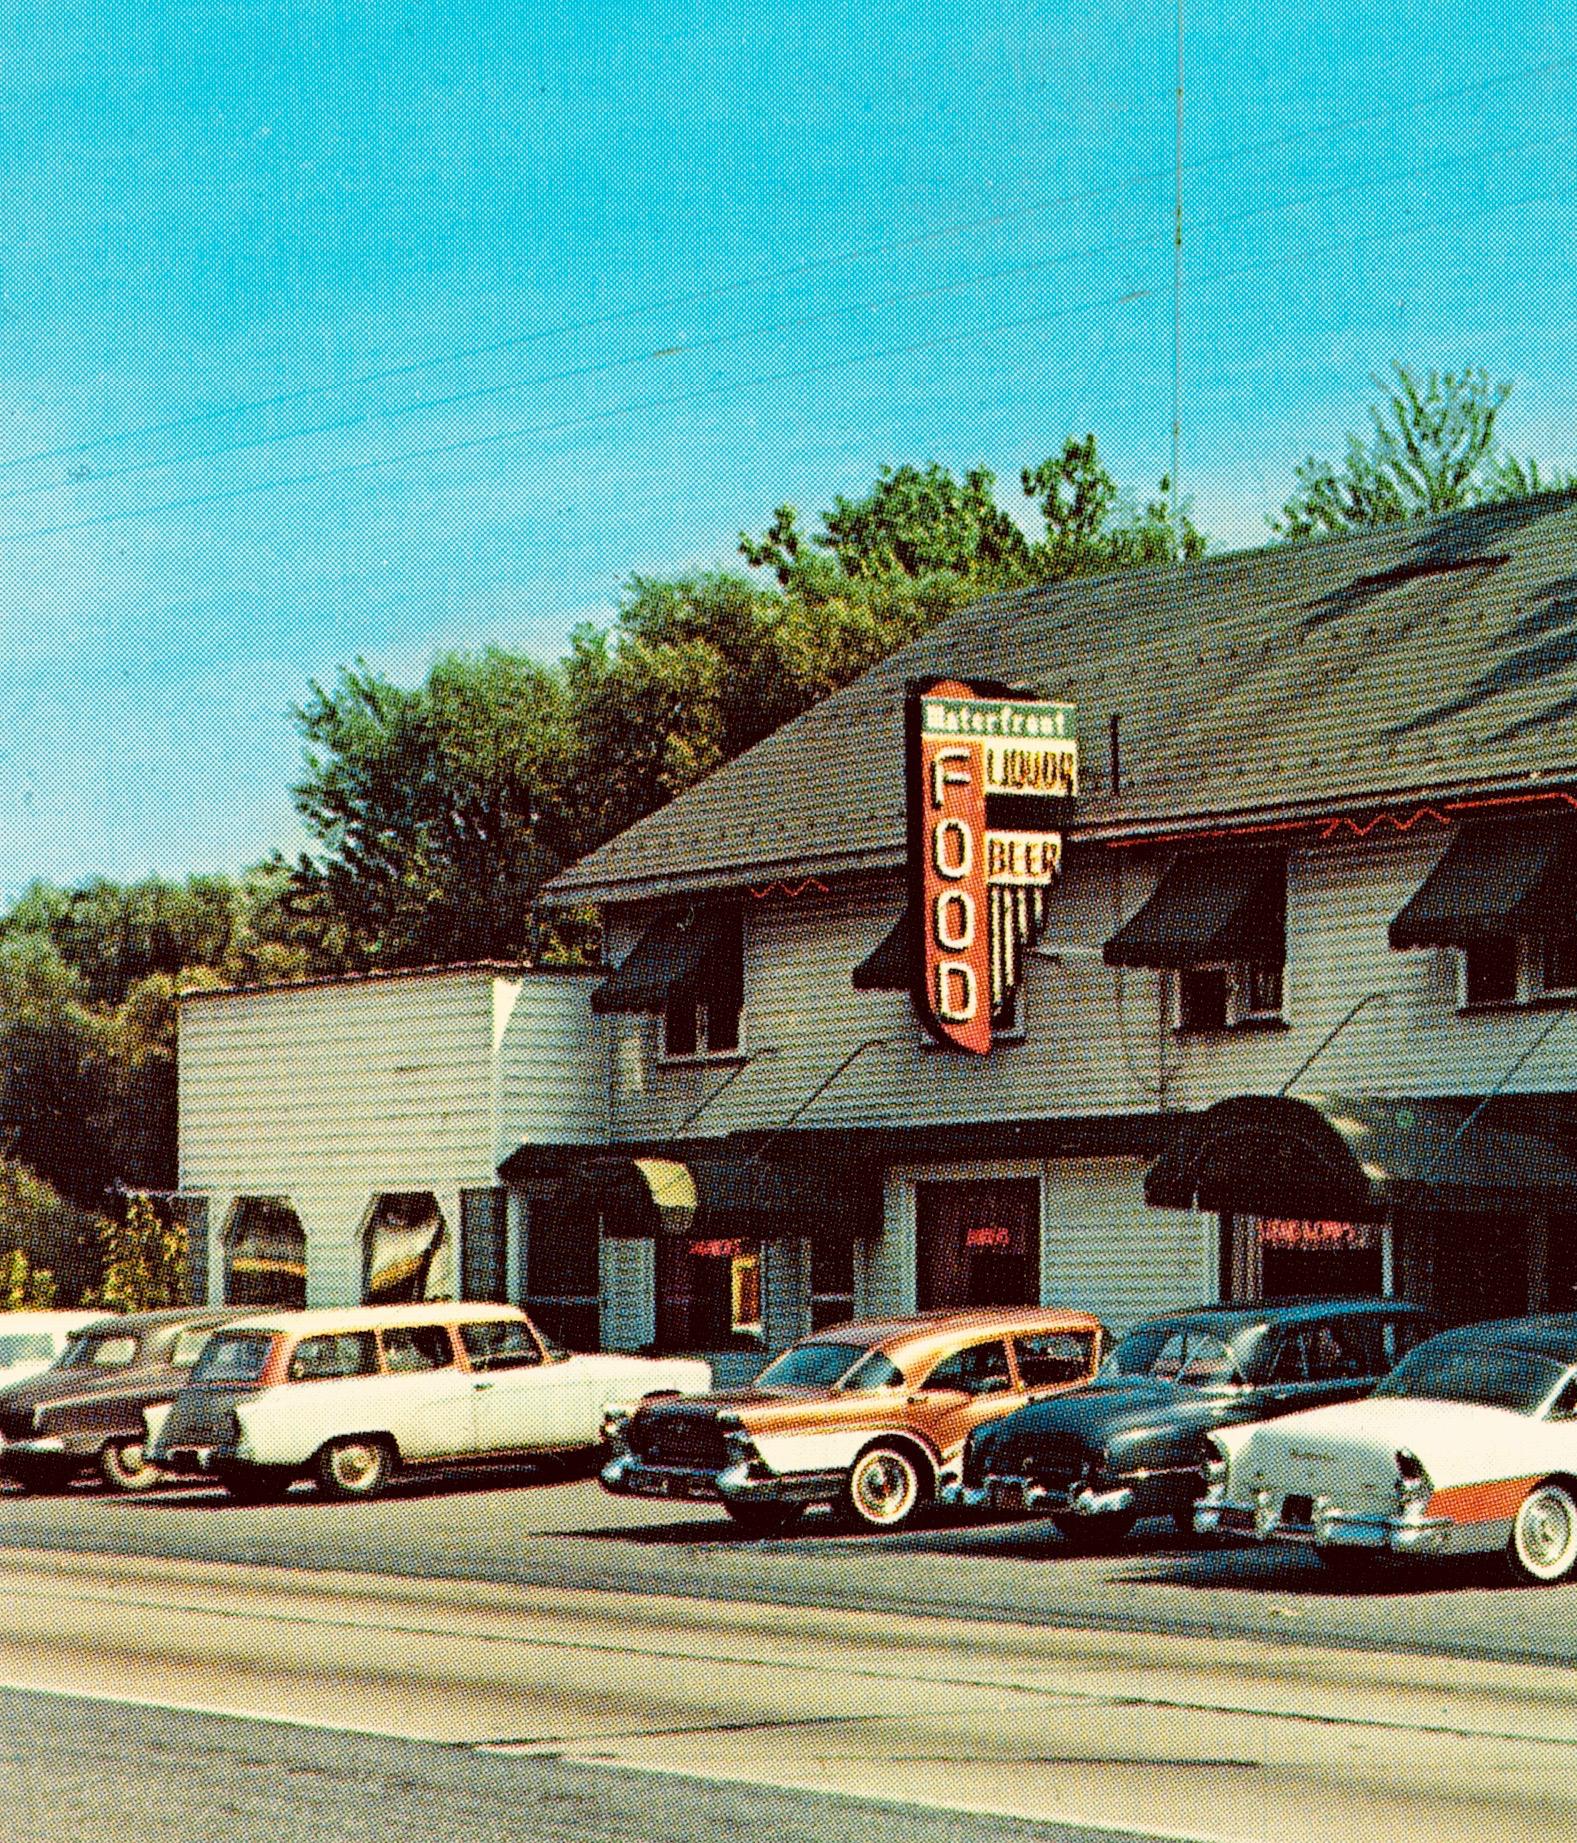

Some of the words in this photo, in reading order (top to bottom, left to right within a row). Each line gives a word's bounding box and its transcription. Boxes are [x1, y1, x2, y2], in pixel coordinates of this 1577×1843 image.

[926, 704, 1064, 735] Waterfront
[986, 749, 1074, 794] LIQUOR
[988, 838, 1059, 877] BEER
[931, 747, 976, 1021] FOOD
